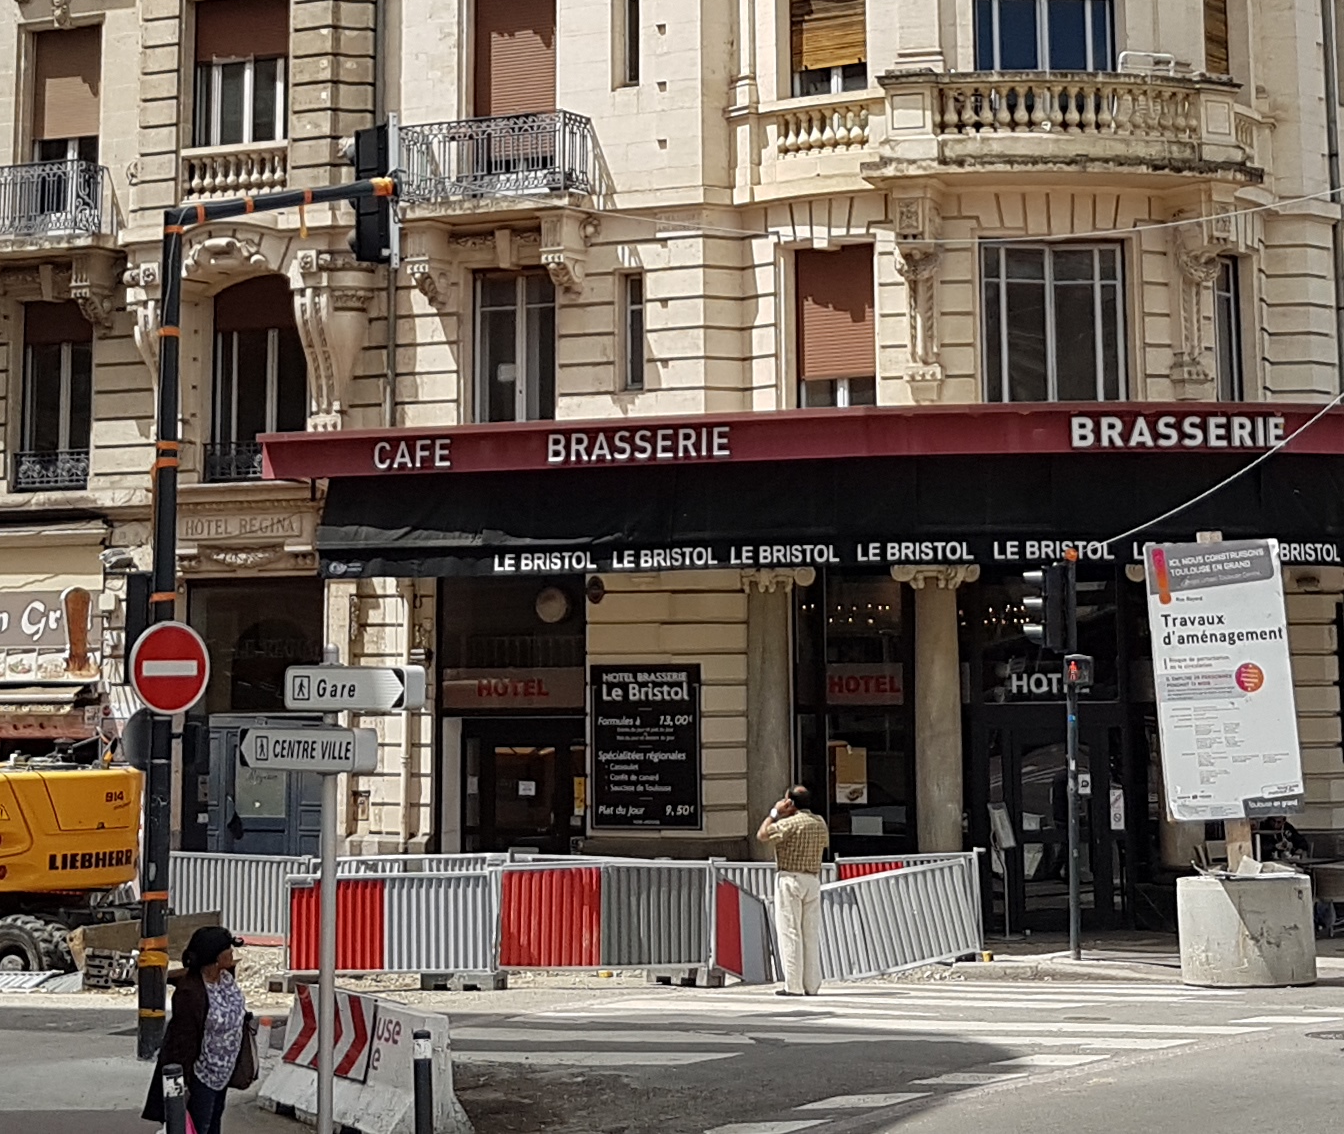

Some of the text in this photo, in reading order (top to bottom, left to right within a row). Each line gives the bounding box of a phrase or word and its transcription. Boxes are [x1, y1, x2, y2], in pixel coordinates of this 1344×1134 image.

[1070, 415, 1286, 448] BRASSERIE
[373, 426, 731, 469] CAFE BRASSERIE
[493, 553, 516, 571] LE
[521, 552, 597, 570] BRISTOL
[612, 550, 635, 568] LE
[640, 548, 718, 567] BRISTOL
[730, 546, 753, 564] LE
[759, 544, 839, 564] BRISTOL
[857, 543, 881, 561] LE
[887, 541, 974, 560] BRISTOL
[993, 541, 1020, 560] LE
[1133, 542, 1144, 560] L
[1280, 543, 1341, 562] BRISTOL
[1161, 612, 1225, 629] Travaux
[1162, 627, 1283, 645] d'aménagement
[602, 672, 688, 682] HOTEL BRASSERIE
[828, 674, 901, 695] HOTEL
[1011, 673, 1090, 694] HOT
[316, 679, 356, 698] Gare
[477, 678, 549, 697] HOTEL
[602, 682, 689, 701] Le Bristol
[598, 716, 634, 726] Formules
[272, 739, 352, 761] CENTRE VILLE
[599, 805, 614, 815] Plat
[48, 849, 133, 871] LIEBHERR
